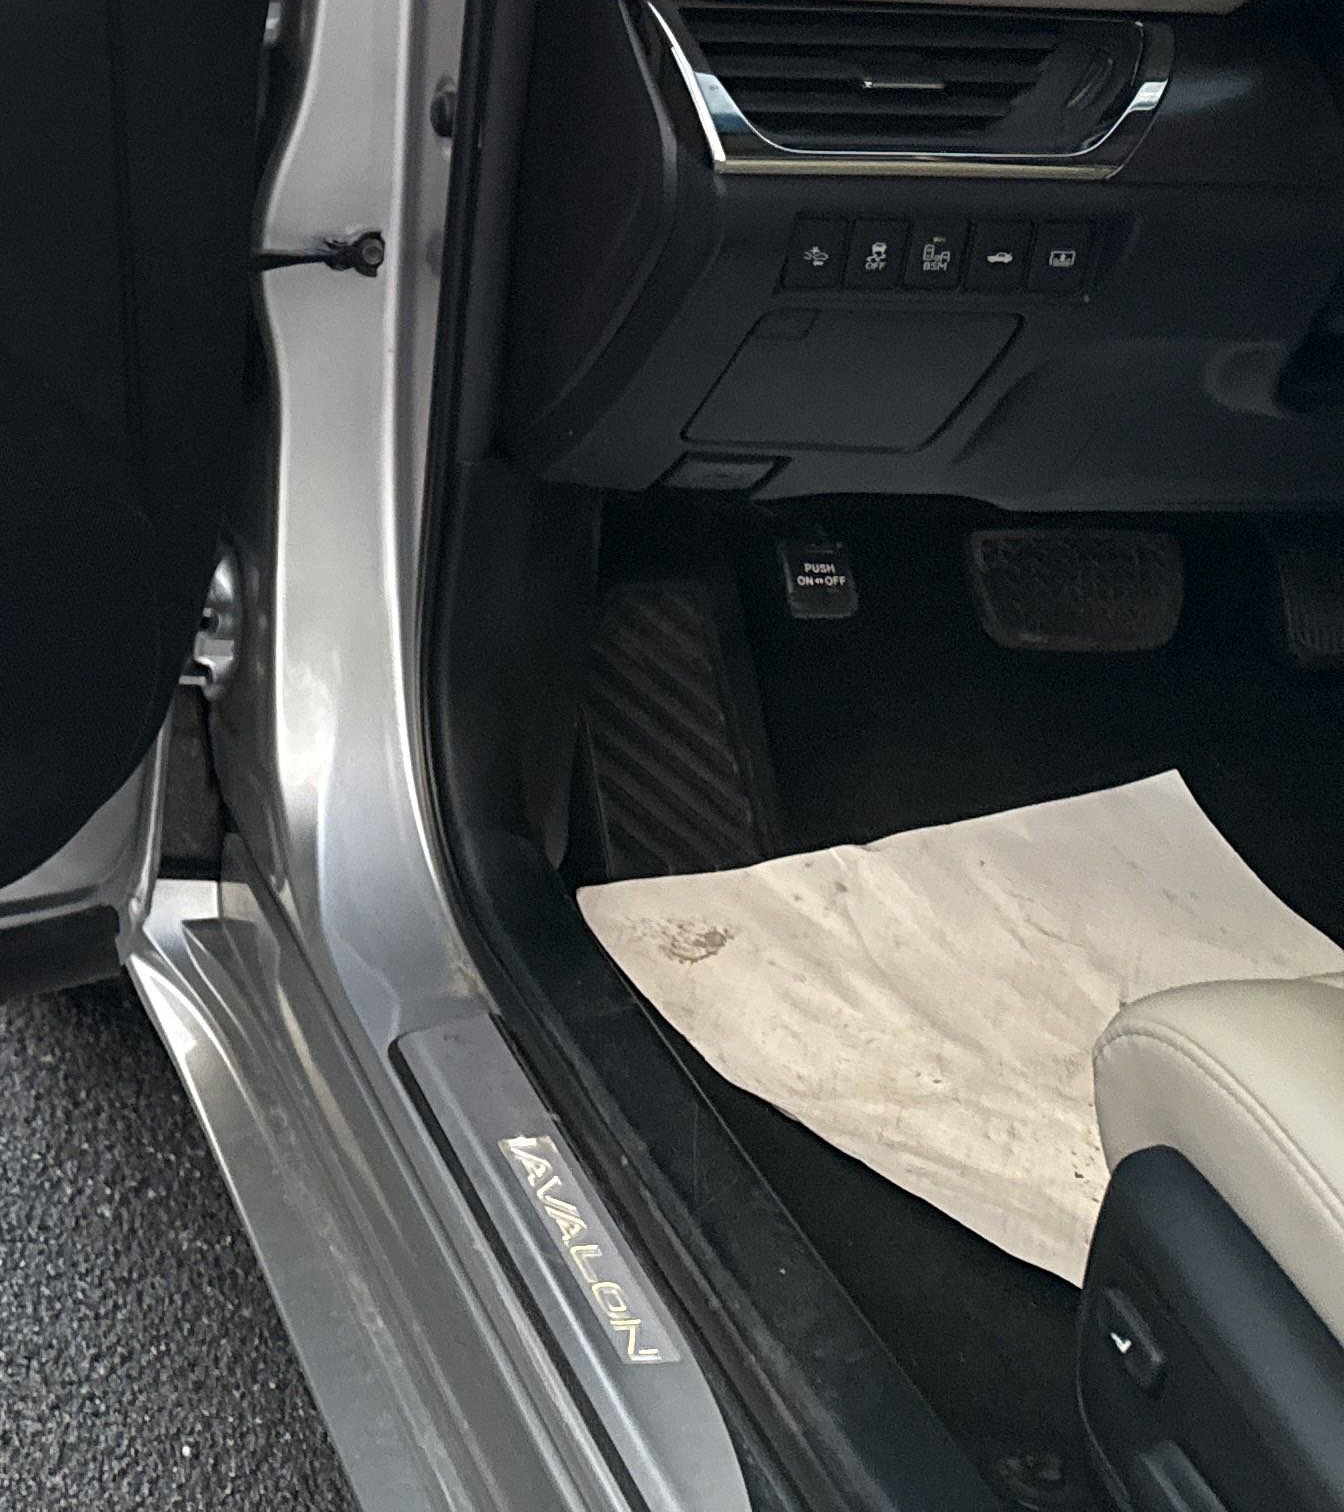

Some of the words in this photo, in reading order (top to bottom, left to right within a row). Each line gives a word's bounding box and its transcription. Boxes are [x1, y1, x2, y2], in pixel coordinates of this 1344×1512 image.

[865, 261, 887, 271] OFF
[922, 261, 948, 271] BSM
[803, 562, 836, 574] PUSH
[509, 1144, 662, 1361] AVALON
